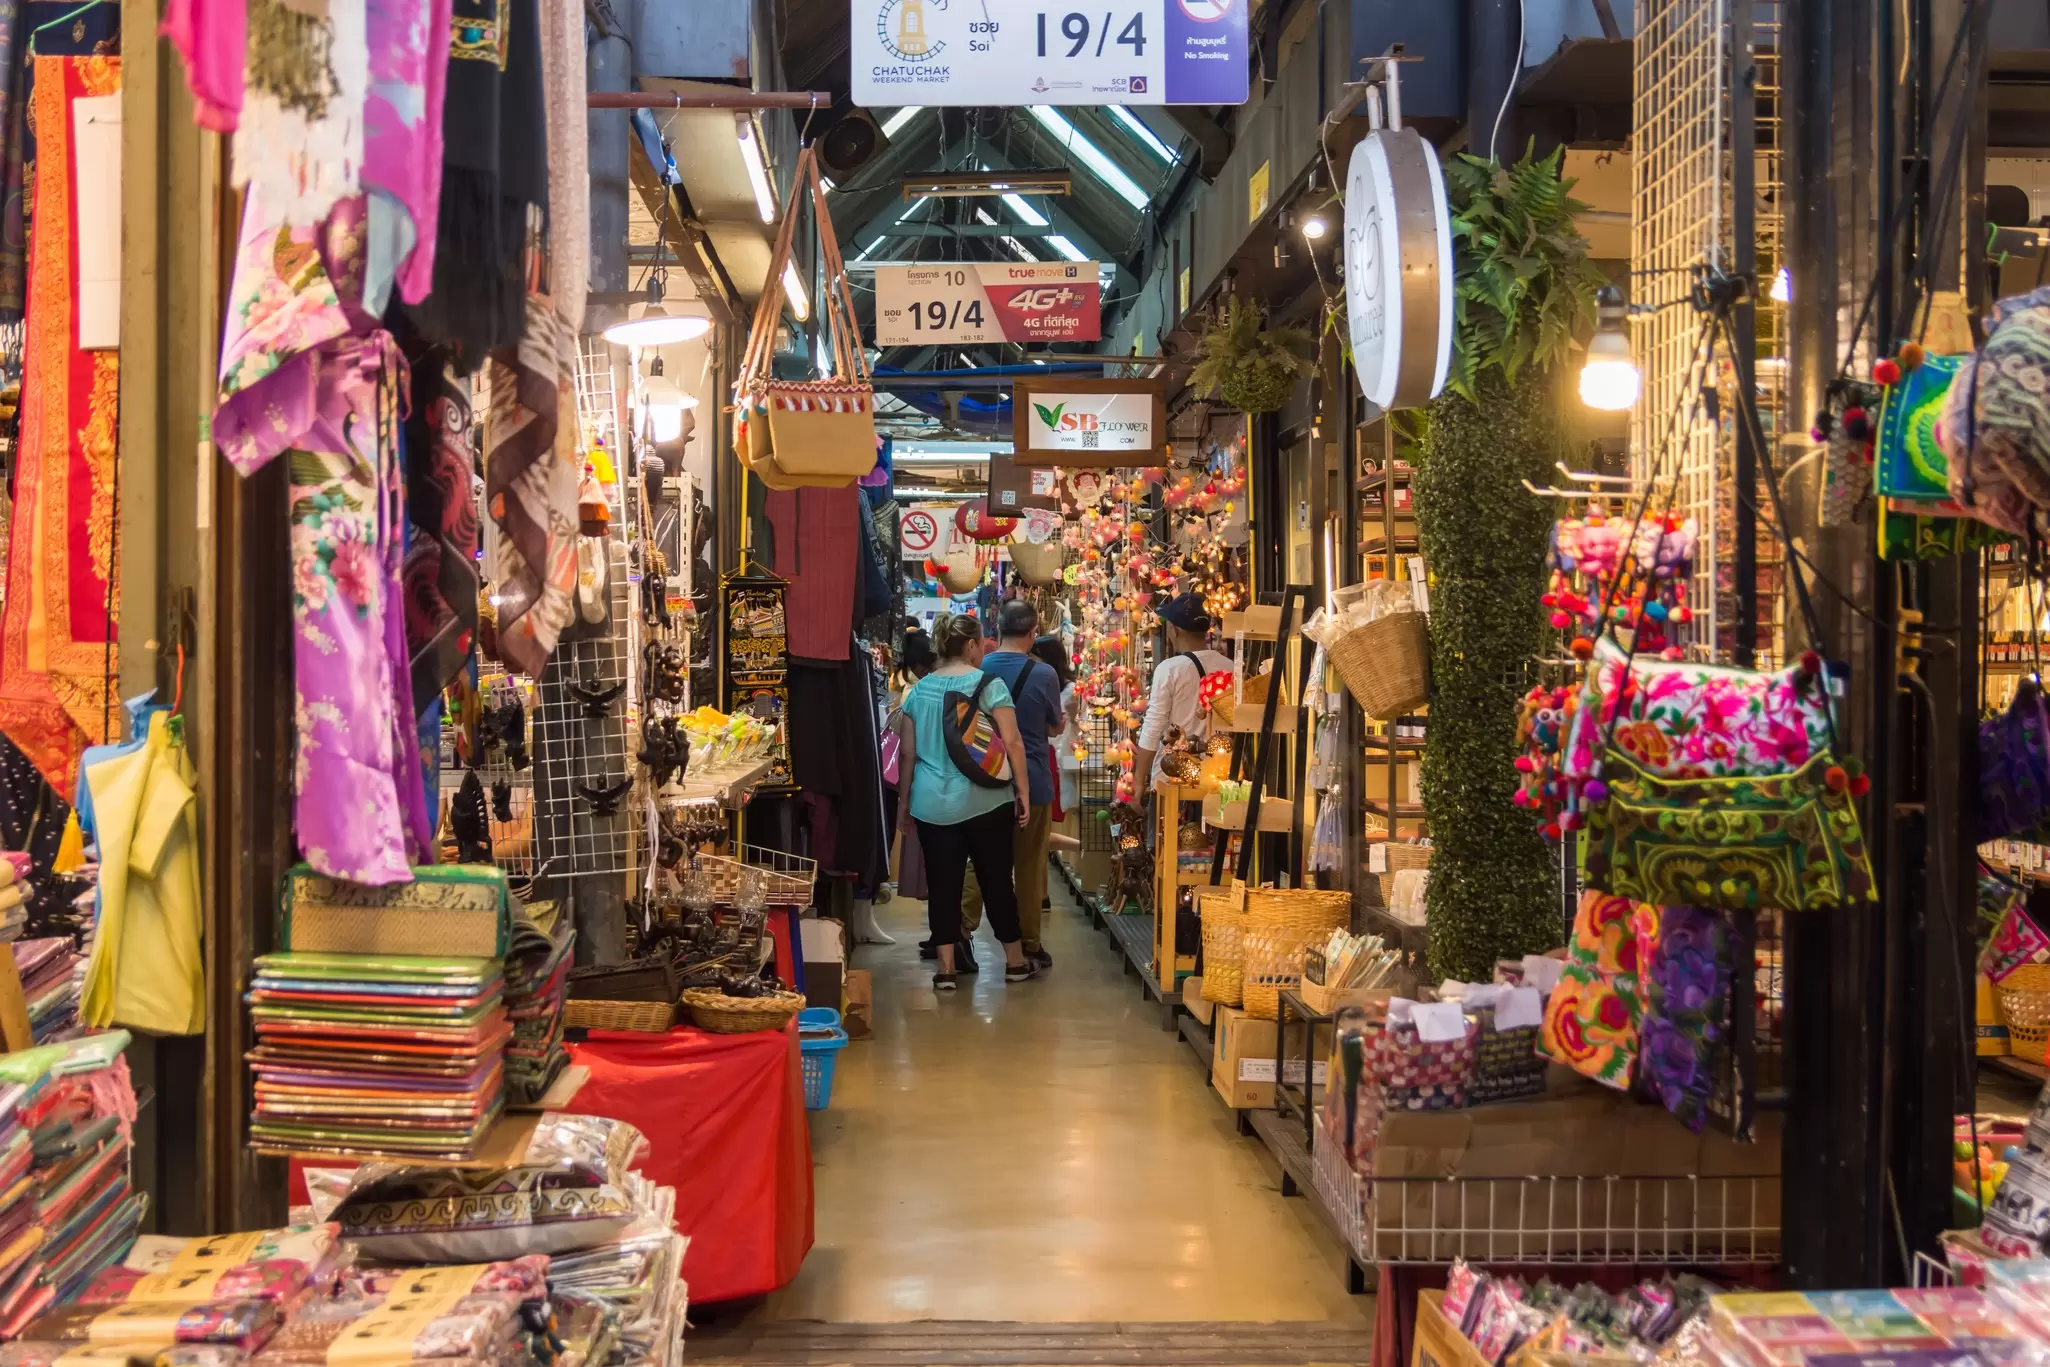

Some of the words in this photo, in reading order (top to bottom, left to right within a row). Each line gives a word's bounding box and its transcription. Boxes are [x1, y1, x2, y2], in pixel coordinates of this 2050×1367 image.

[969, 21, 1000, 33] ซอย
[1036, 11, 1147, 58] 19/4
[969, 40, 990, 51] Soi
[1184, 51, 1197, 59] No
[1198, 51, 1229, 61] Smoking
[872, 66, 950, 76] CHATUCHAK
[907, 270, 940, 279] โครงการ
[944, 270, 966, 286] 10
[907, 300, 985, 330] 19/4
[1023, 318, 1040, 328] 4G
[1060, 412, 1098, 431] SB
[1246, 1092, 1258, 1101] 60
